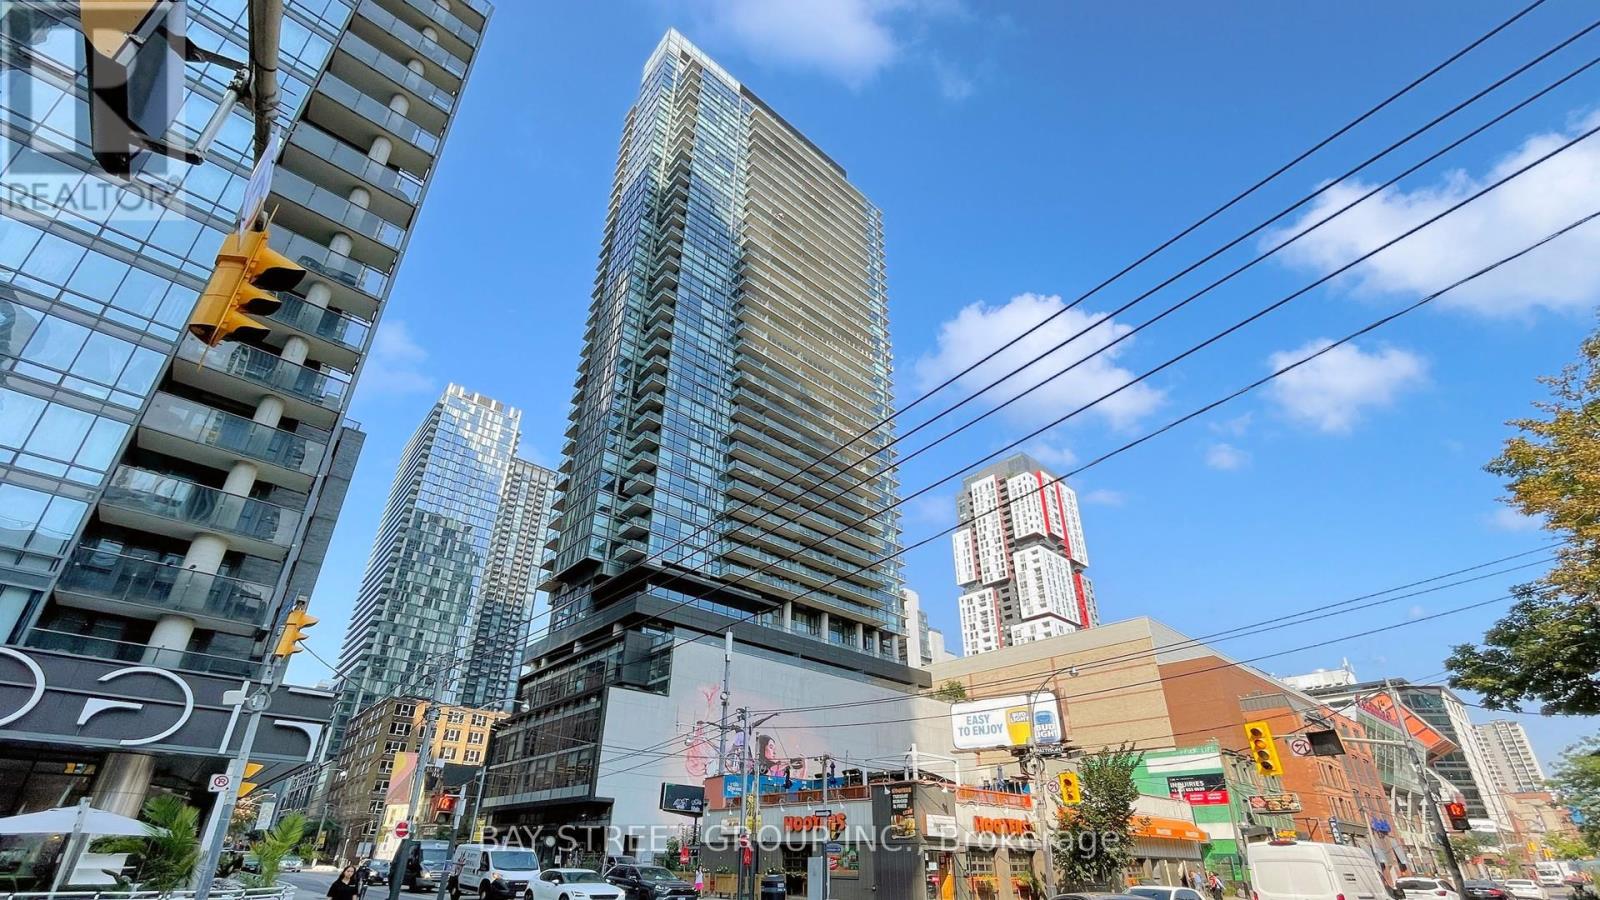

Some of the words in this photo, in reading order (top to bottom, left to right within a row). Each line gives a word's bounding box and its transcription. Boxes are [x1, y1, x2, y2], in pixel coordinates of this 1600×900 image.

[966, 714, 990, 725] EASY
[958, 727, 970, 737] TO
[973, 723, 1003, 736] ENJOY
[784, 812, 846, 832] HOOTRS
